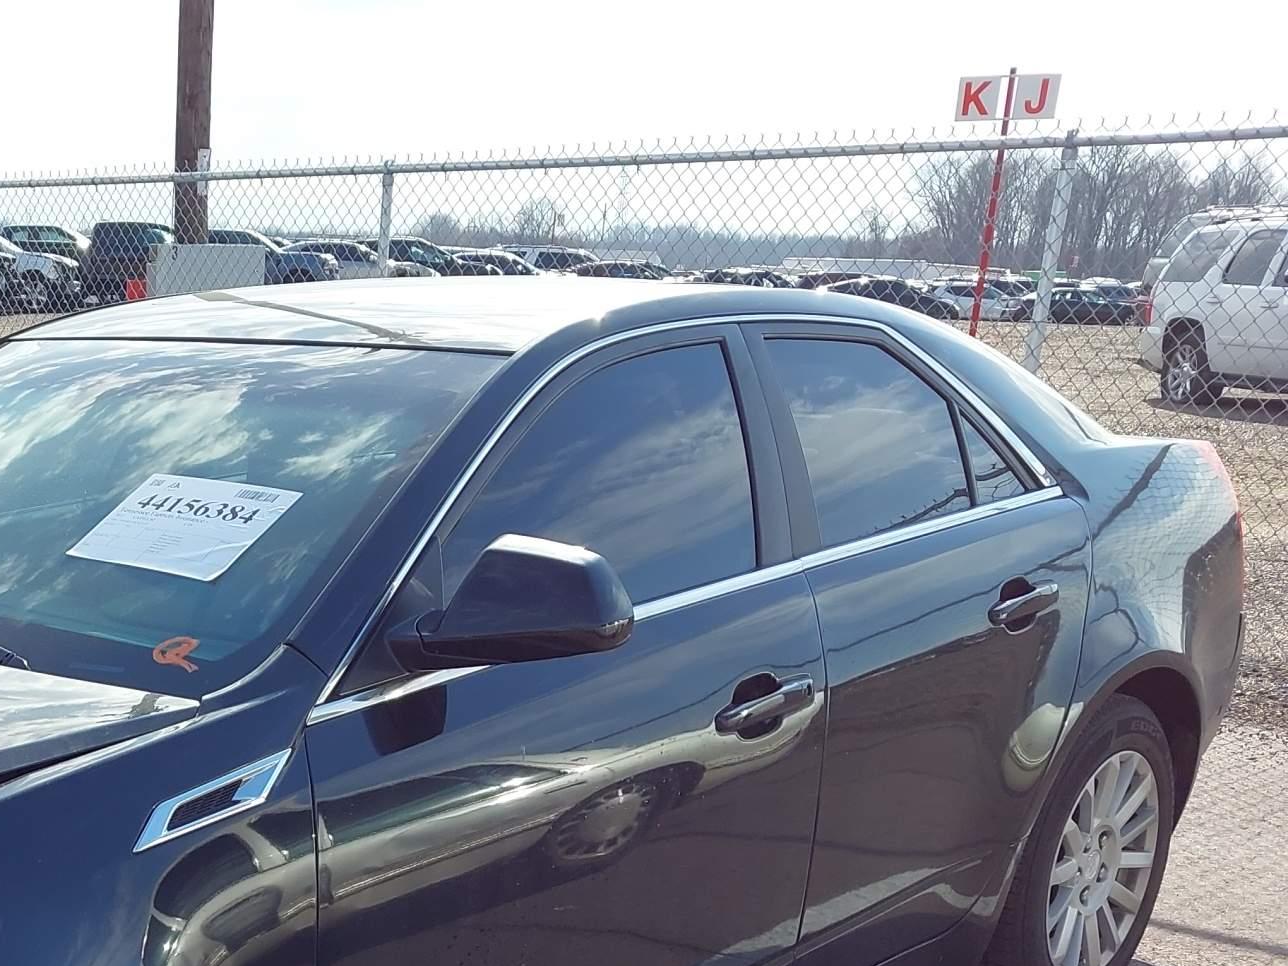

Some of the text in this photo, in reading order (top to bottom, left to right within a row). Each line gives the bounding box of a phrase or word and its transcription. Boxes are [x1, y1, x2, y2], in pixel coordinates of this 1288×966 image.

[961, 80, 992, 116] K
[1024, 78, 1050, 115] J
[137, 493, 261, 524] 44156384
